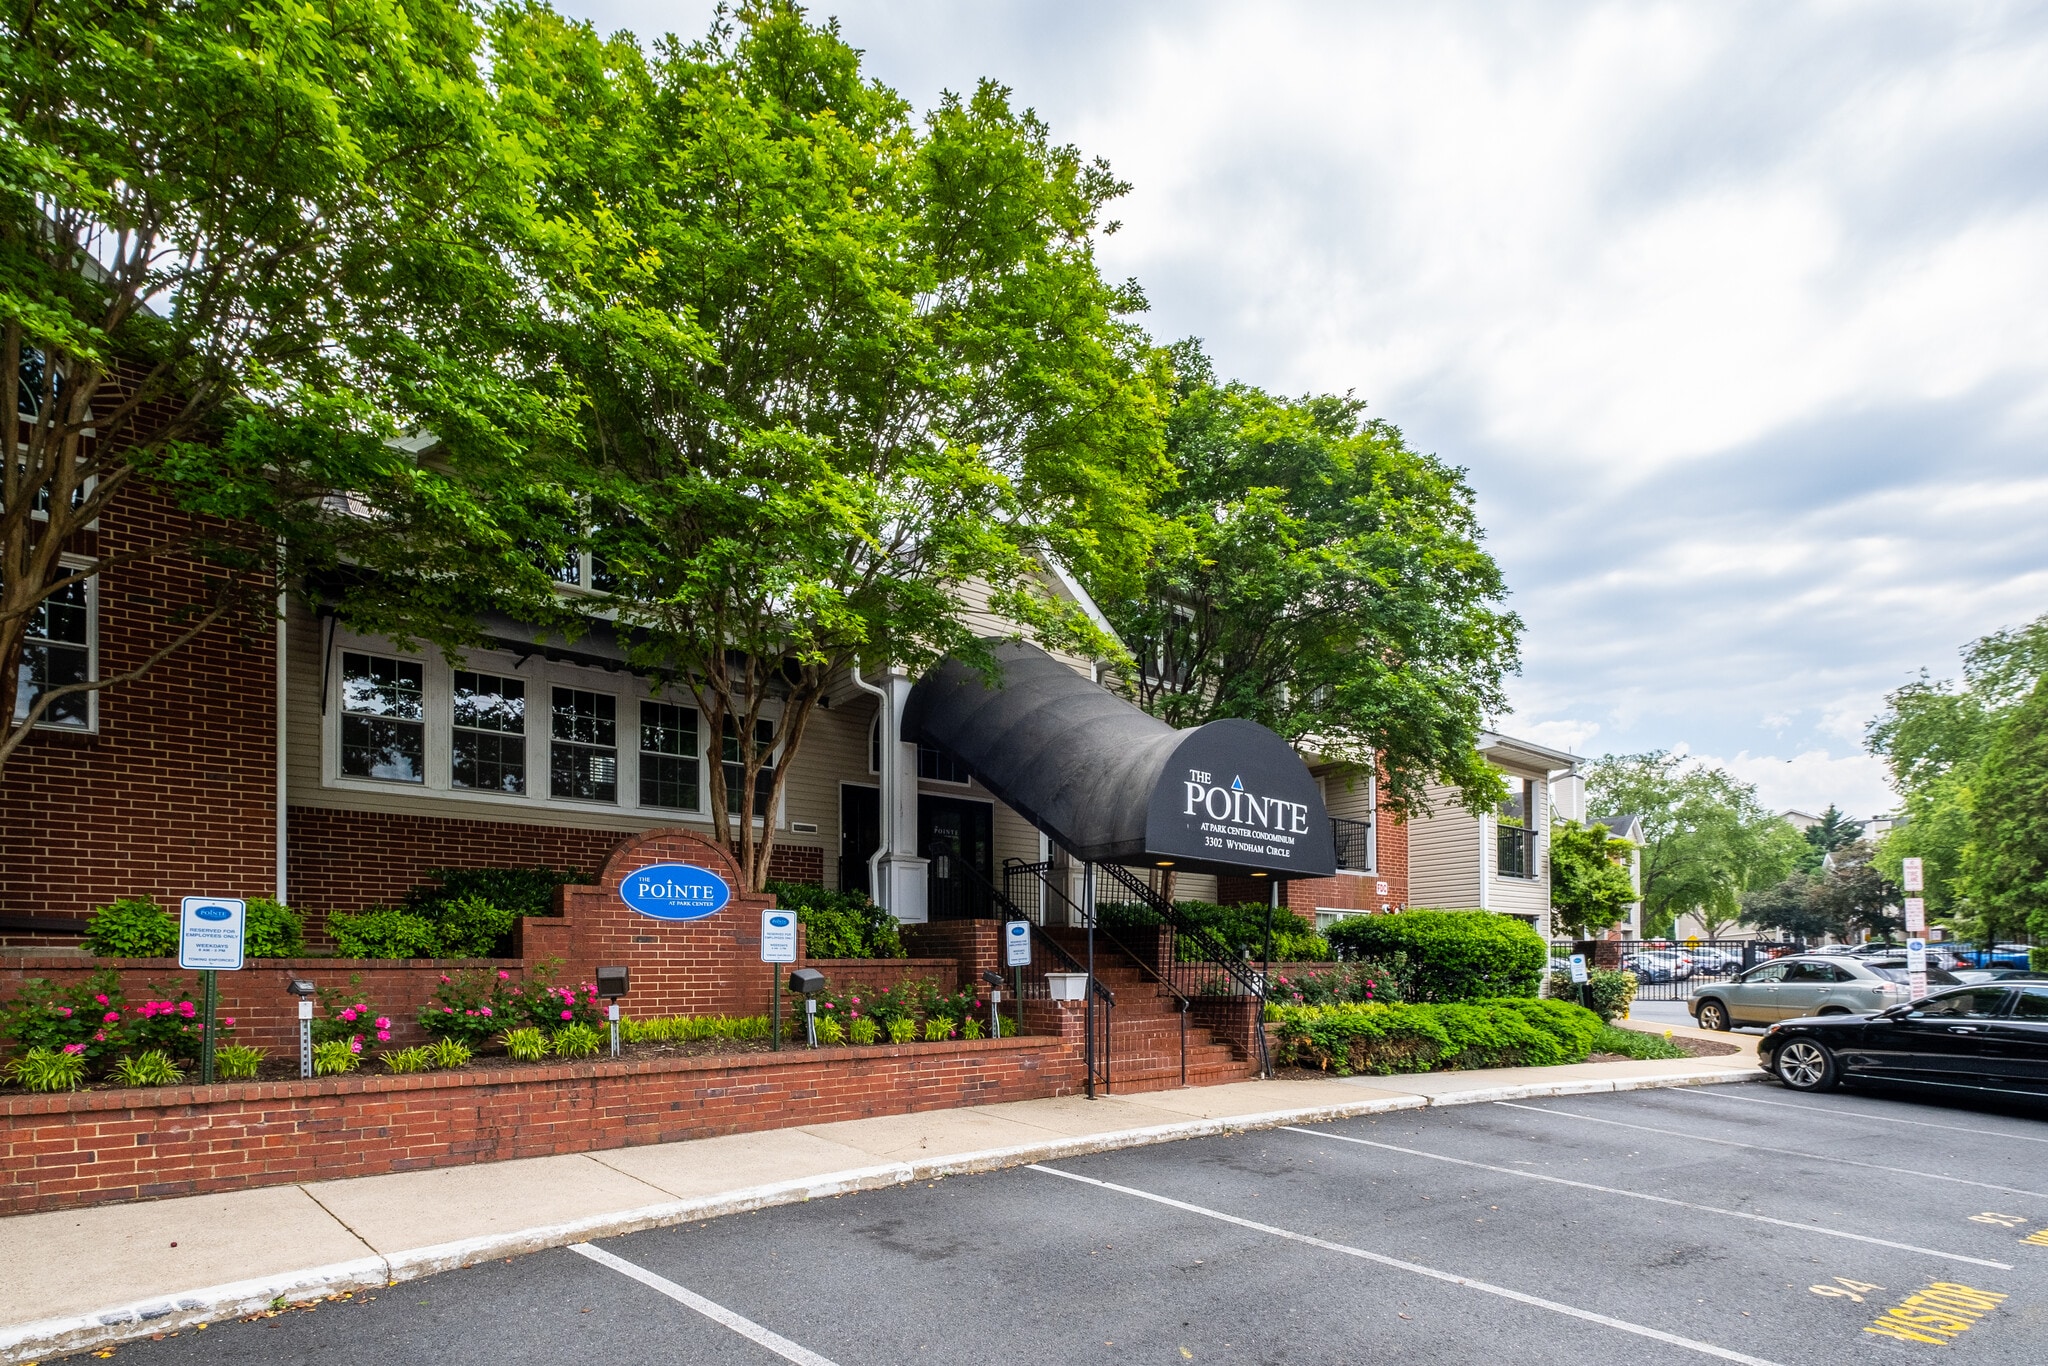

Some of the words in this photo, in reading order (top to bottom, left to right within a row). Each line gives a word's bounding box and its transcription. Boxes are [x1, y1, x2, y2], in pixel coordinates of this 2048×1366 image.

[1189, 769, 1212, 784] THE
[1183, 781, 1309, 834] POINTE
[1200, 822, 1209, 831] AT
[1209, 823, 1227, 834] PARK
[1227, 826, 1252, 838] CENTER
[1251, 830, 1295, 845] CONDOMINIUM
[1205, 836, 1223, 848] 3302
[1226, 839, 1264, 854] WYNDHAM
[1266, 845, 1291, 858] CIRCLE
[638, 883, 714, 899] POINTE
[1808, 1276, 1887, 1303] 94
[1862, 1282, 2010, 1346] VISITOR
